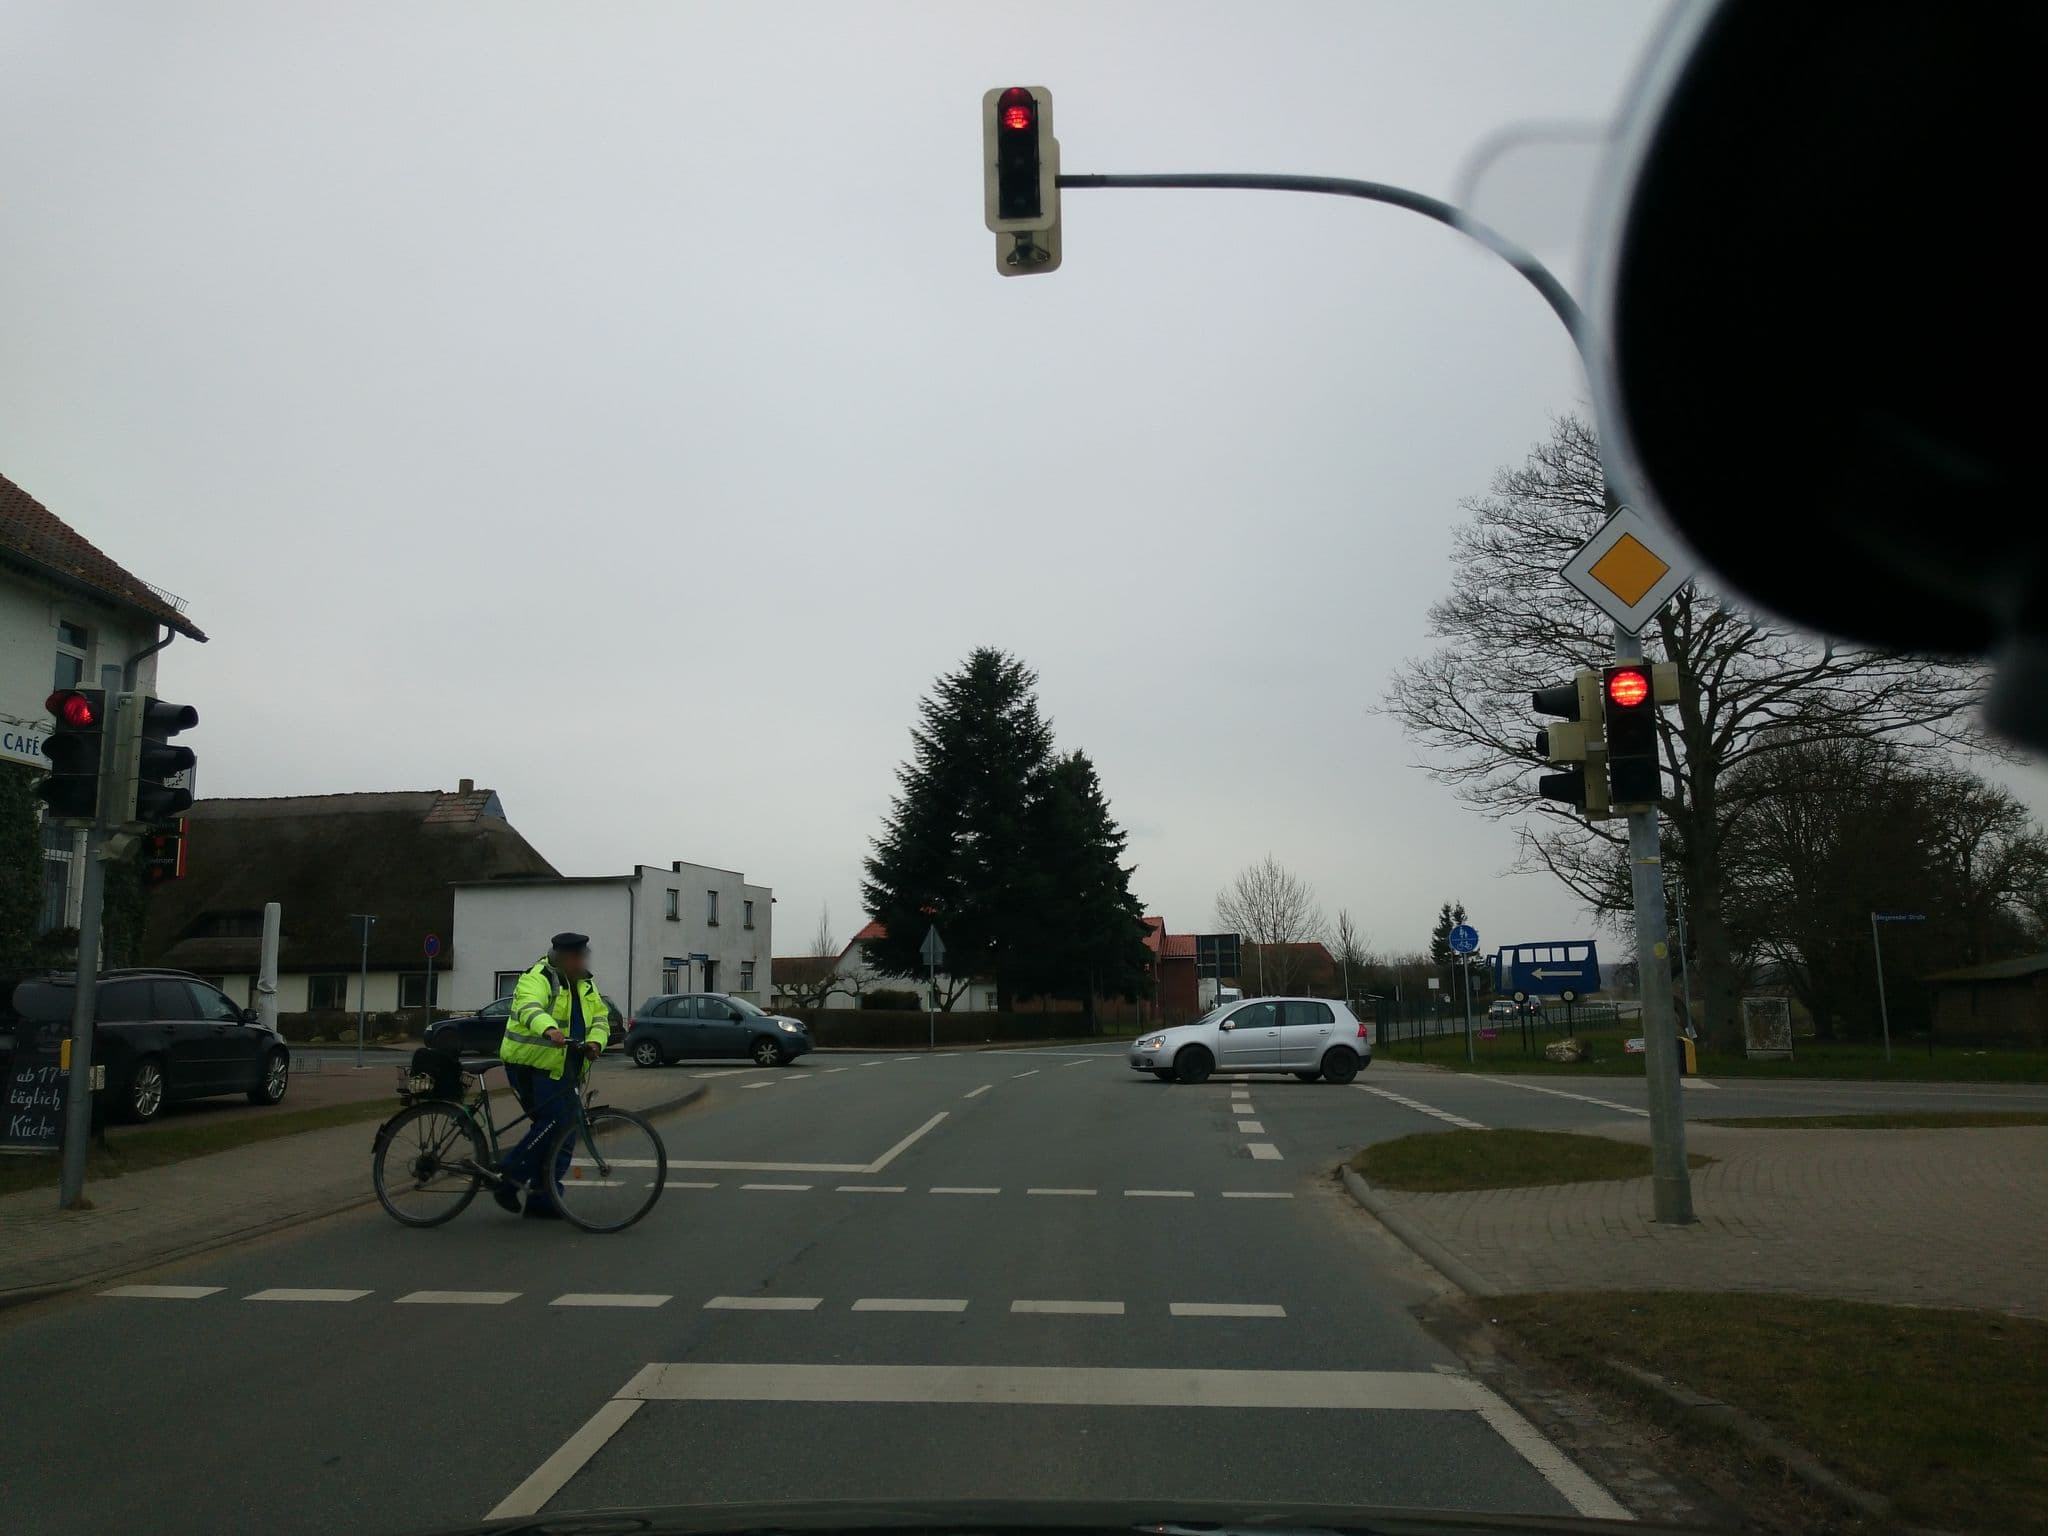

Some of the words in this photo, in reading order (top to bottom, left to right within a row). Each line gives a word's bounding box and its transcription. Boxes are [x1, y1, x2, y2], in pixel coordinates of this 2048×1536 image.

[4, 733, 39, 756] CAFÉ
[16, 1067, 35, 1082] ab
[10, 1088, 60, 1110] täglich
[9, 1115, 55, 1139] Küche
